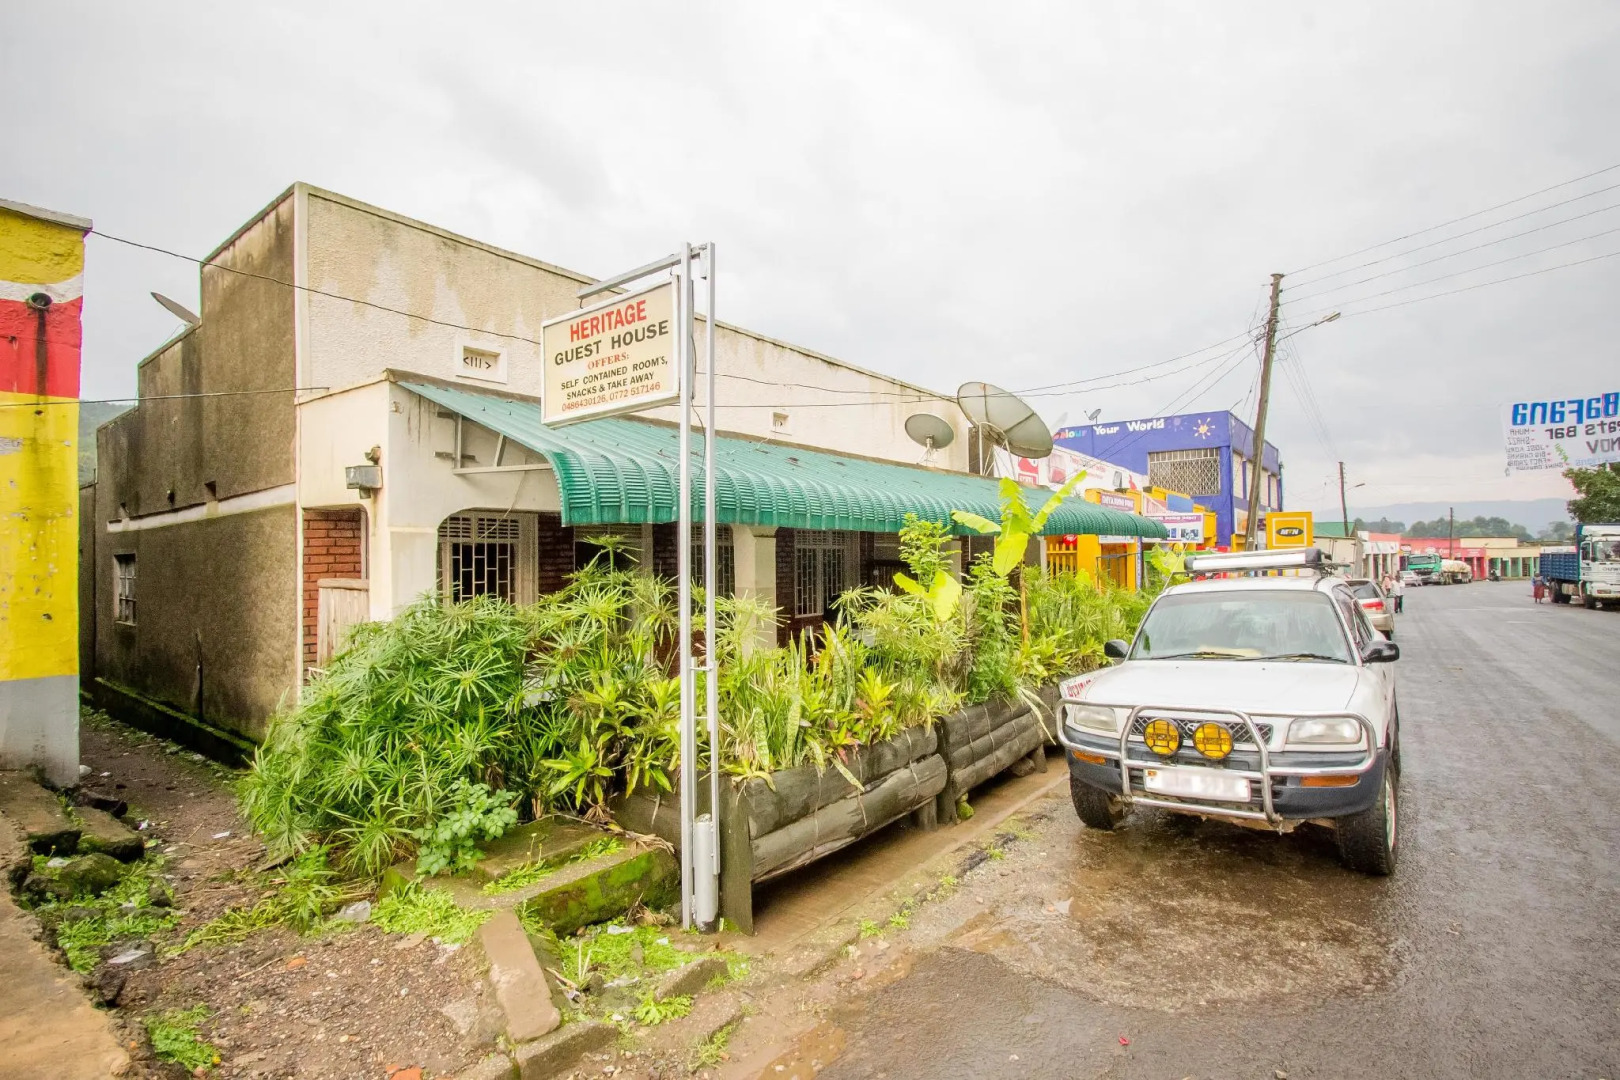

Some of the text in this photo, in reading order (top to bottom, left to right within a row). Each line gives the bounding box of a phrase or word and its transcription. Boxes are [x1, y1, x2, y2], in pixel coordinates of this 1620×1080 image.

[570, 300, 647, 342] HERITAGE
[554, 320, 669, 366] GUEST HOUSE
[587, 352, 630, 370] OFFERS:
[561, 378, 580, 390] SELF
[582, 366, 628, 385] CONTAINED
[566, 372, 655, 400] SNACKS & TAKE AWAY
[609, 389, 629, 402] 0772
[630, 381, 661, 396] 517146
[1093, 425, 1119, 436] Your
[1126, 418, 1165, 432] World
[1280, 528, 1300, 536] MTN
